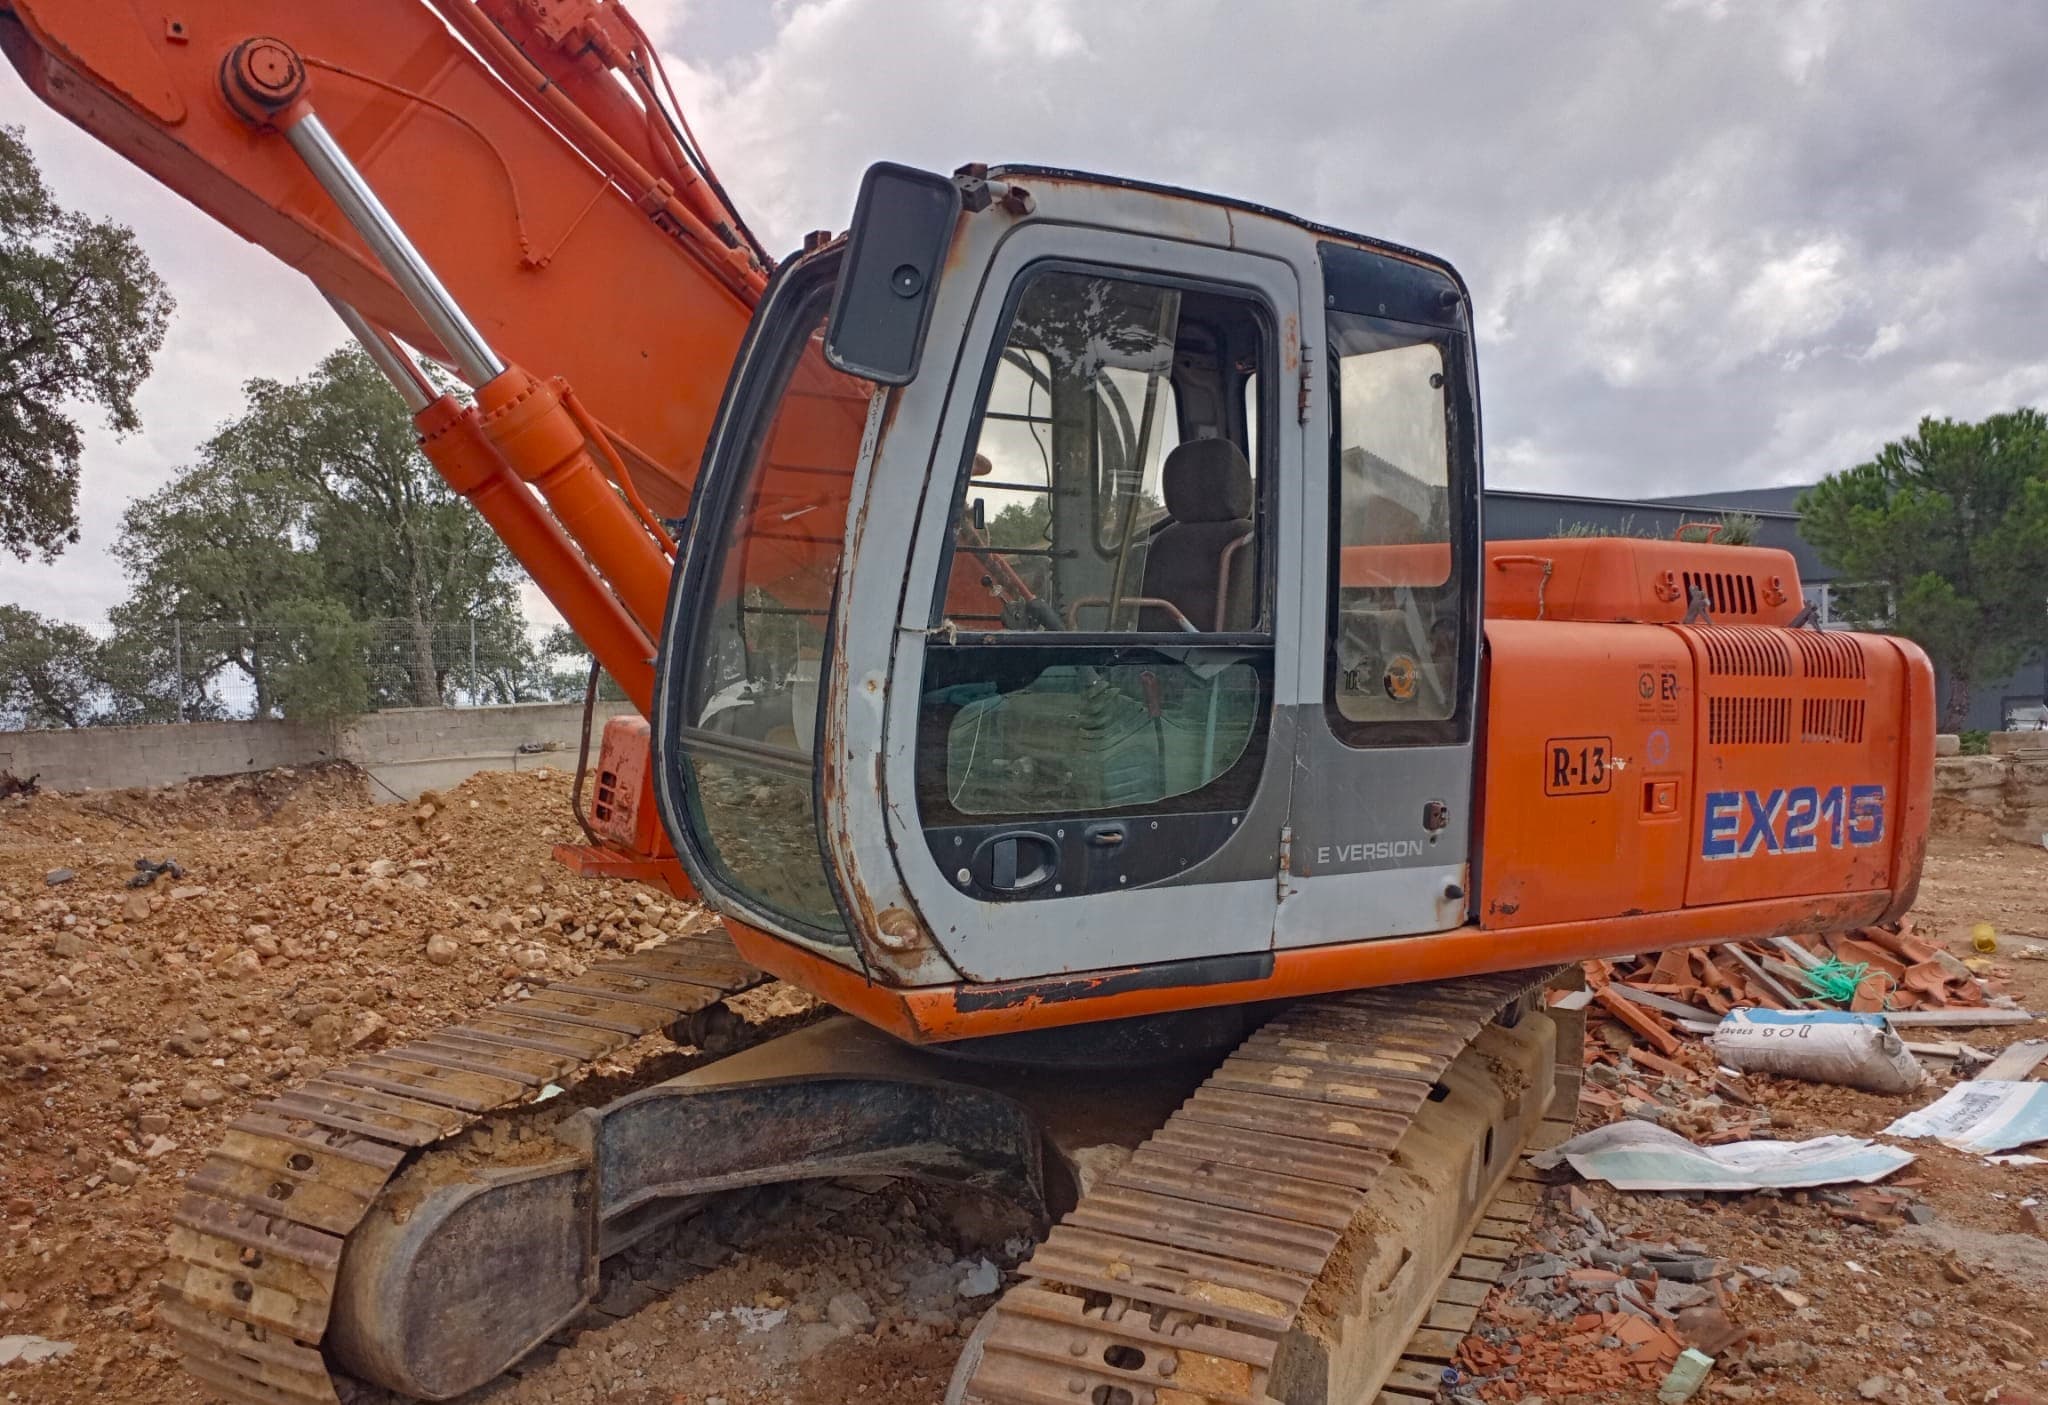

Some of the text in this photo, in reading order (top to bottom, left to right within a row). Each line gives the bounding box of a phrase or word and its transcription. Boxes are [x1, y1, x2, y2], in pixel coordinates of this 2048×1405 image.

[1553, 747, 1604, 786] R-13
[1702, 785, 1886, 861] EX215
[1317, 839, 1423, 864] E VERSION
